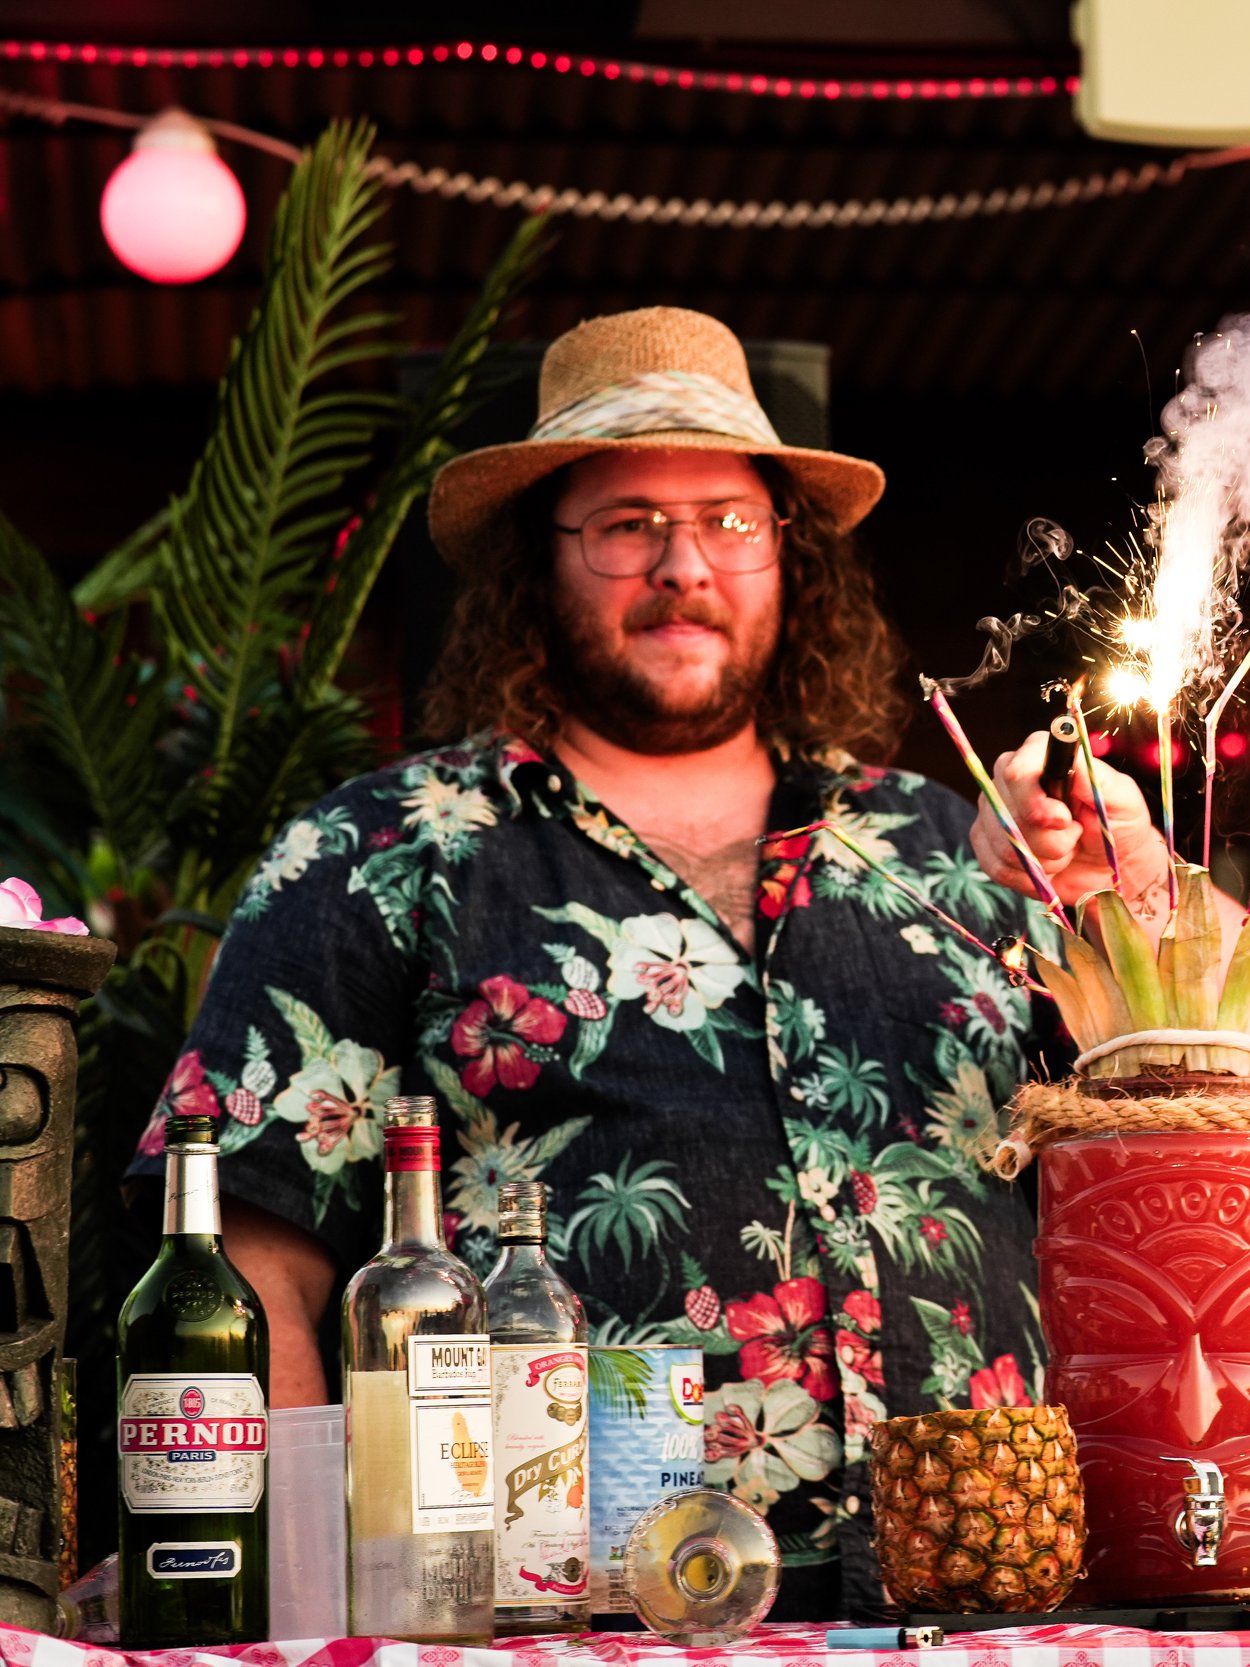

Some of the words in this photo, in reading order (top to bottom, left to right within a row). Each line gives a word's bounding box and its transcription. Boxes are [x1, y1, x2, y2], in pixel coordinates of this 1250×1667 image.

[431, 1347, 474, 1368] MOUNT
[184, 1398, 201, 1409] 1805
[122, 1422, 263, 1446] PERNOD
[171, 1452, 213, 1461] PARIS
[440, 1442, 488, 1460] ECLIPSE
[514, 1462, 543, 1492] Dry
